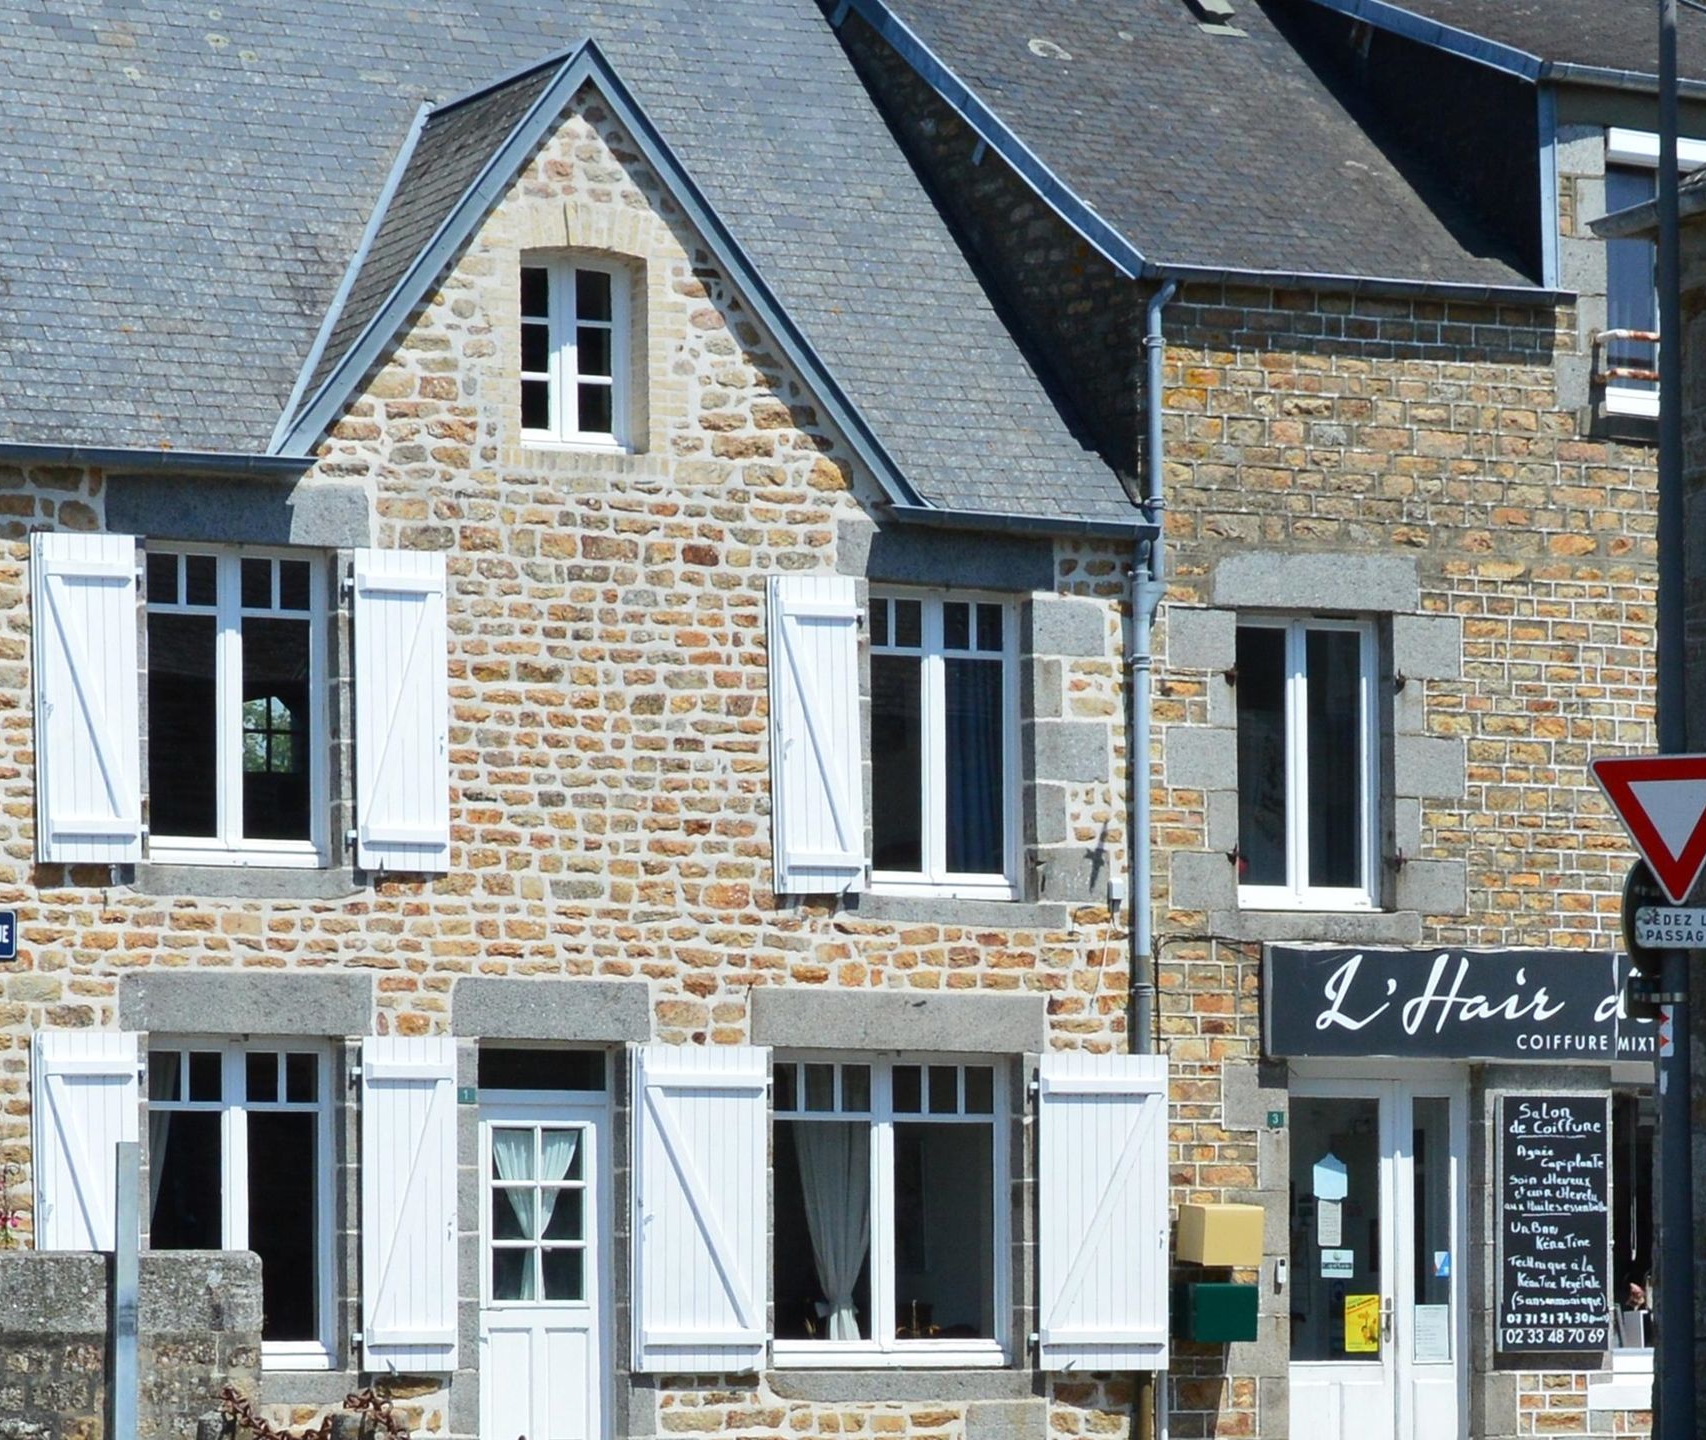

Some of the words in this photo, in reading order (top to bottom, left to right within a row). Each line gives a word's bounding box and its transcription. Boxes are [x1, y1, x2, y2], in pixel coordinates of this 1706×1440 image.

[1516, 1034, 1609, 1051] COIFFURE
[1272, 1113, 1279, 1124] 3
[1519, 1102, 1573, 1120] Salon
[1509, 1119, 1527, 1134] de
[1533, 1119, 1602, 1134] Coiffure
[1506, 1329, 1524, 1344] 02
[1527, 1329, 1544, 1343] 33
[1547, 1329, 1564, 1343] 48
[1567, 1329, 1585, 1343] 70
[1588, 1329, 1605, 1343] 69
